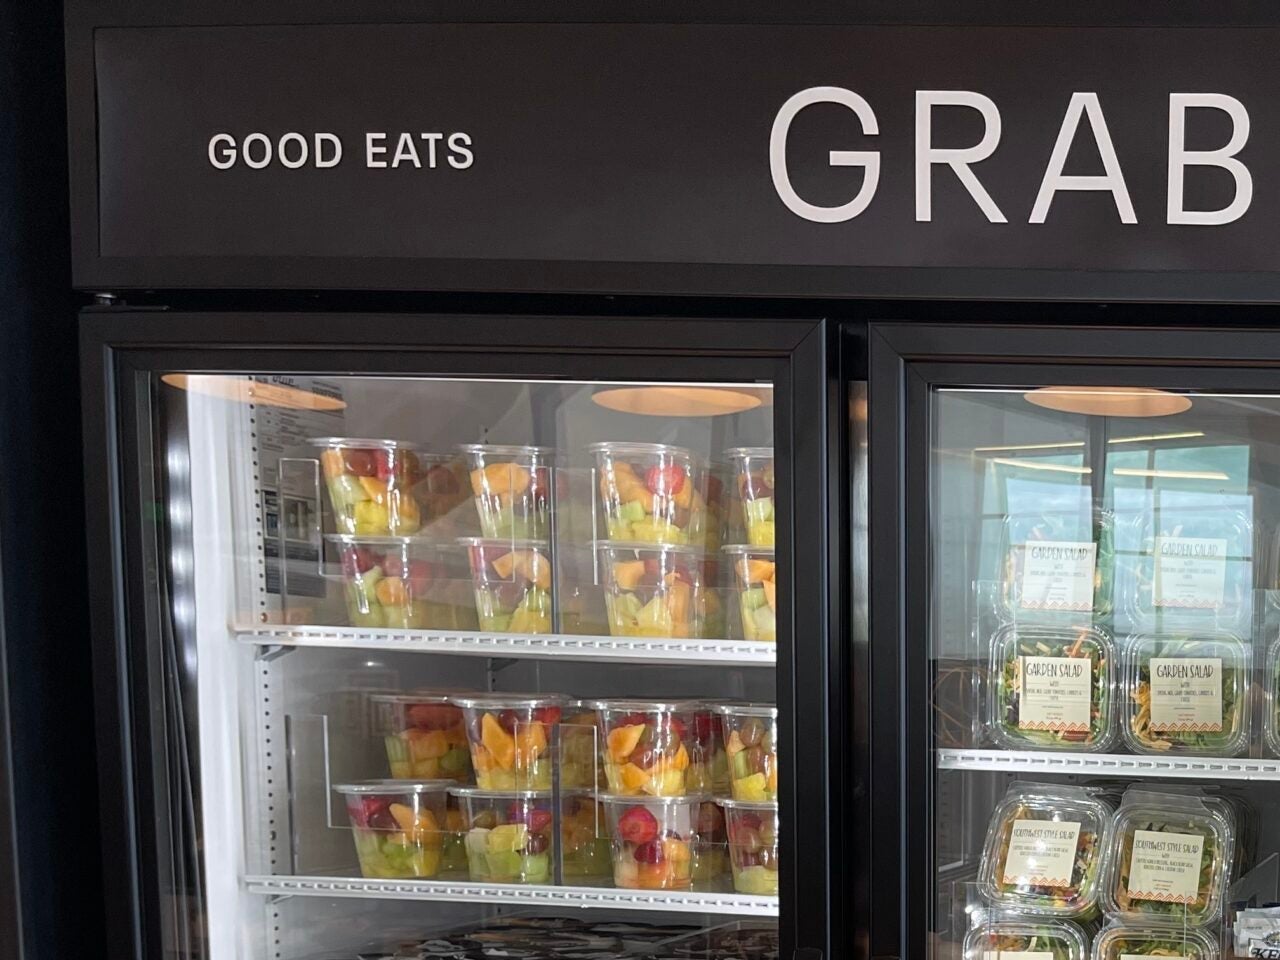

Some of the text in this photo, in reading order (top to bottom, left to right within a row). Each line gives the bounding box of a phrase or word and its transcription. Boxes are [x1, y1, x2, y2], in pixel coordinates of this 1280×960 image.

[208, 132, 474, 170] GOOD EATS
[769, 86, 1253, 226] GRAB
[1031, 546, 1087, 561] GARDEN SALAD
[1161, 542, 1218, 558] GARDEN SALAD
[1026, 663, 1082, 677] GARDEN SALAD
[1156, 665, 1213, 678] GARDEN SALAD
[1135, 839, 1199, 854] SOUTHWEST STYLE SALAD
